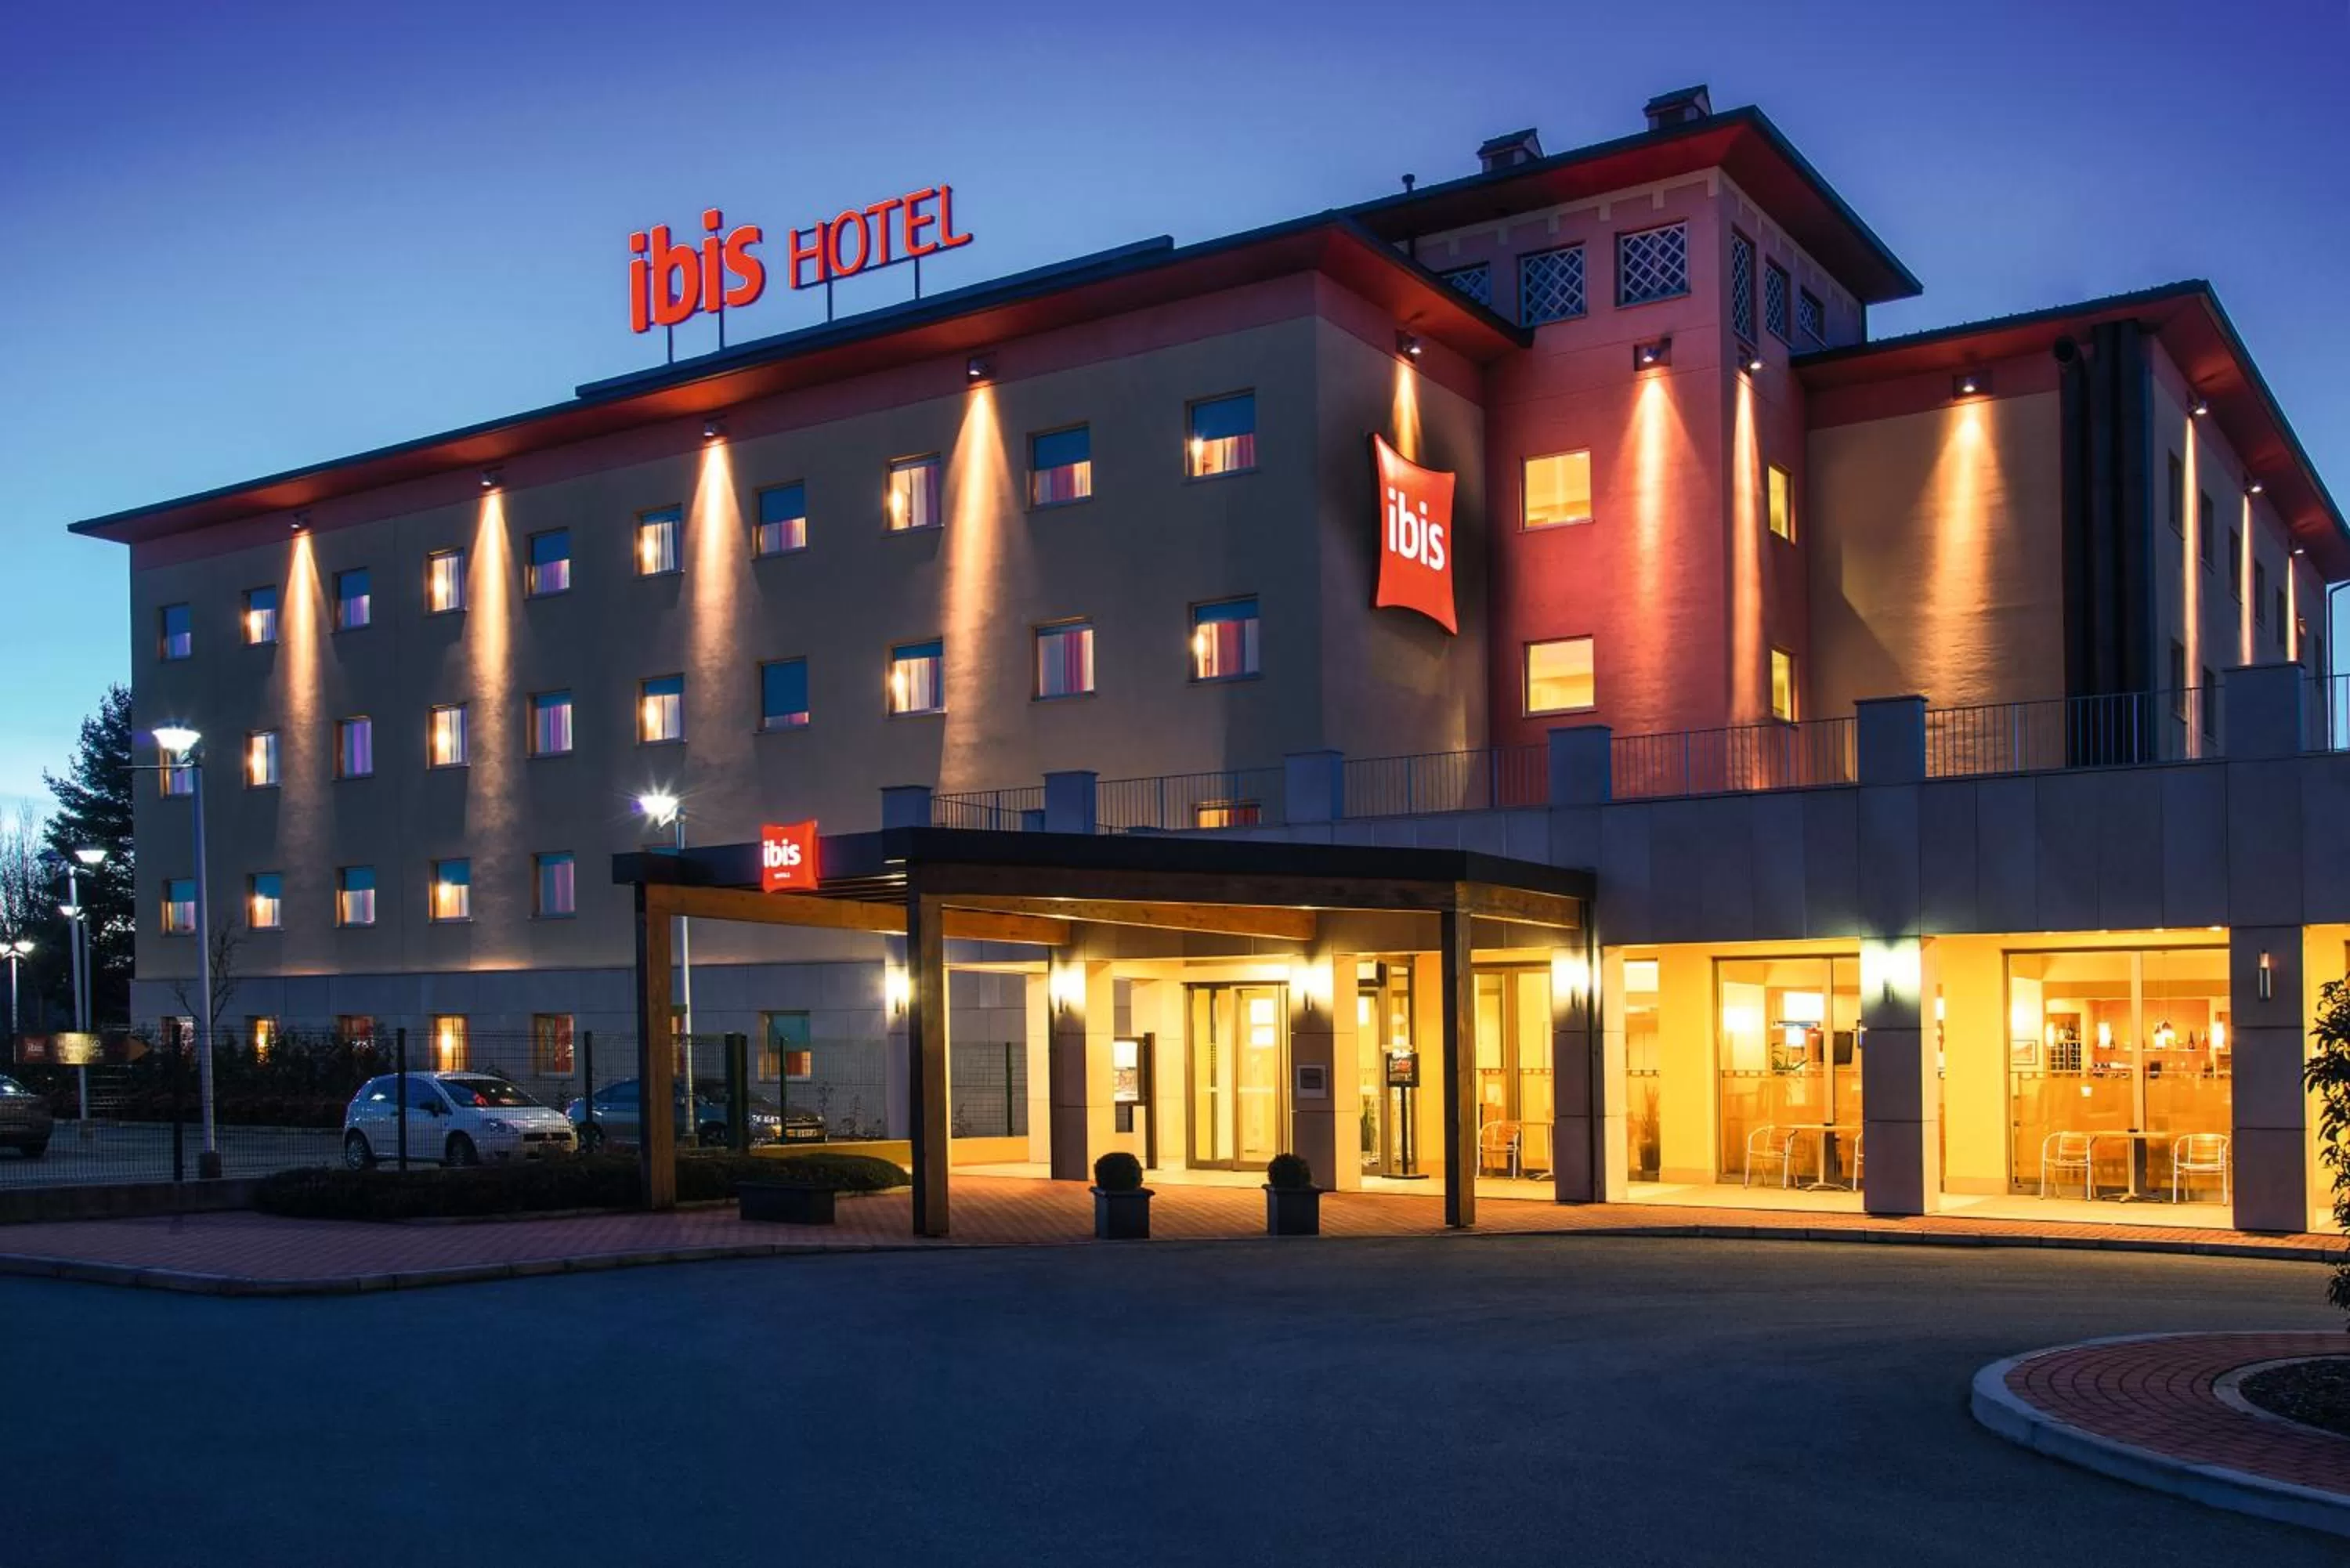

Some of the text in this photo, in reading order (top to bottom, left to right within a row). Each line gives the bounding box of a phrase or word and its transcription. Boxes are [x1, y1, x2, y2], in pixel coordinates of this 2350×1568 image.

[630, 184, 974, 333] ibis HOTEL
[1387, 486, 1445, 571] ibis
[763, 838, 802, 869] ibis
